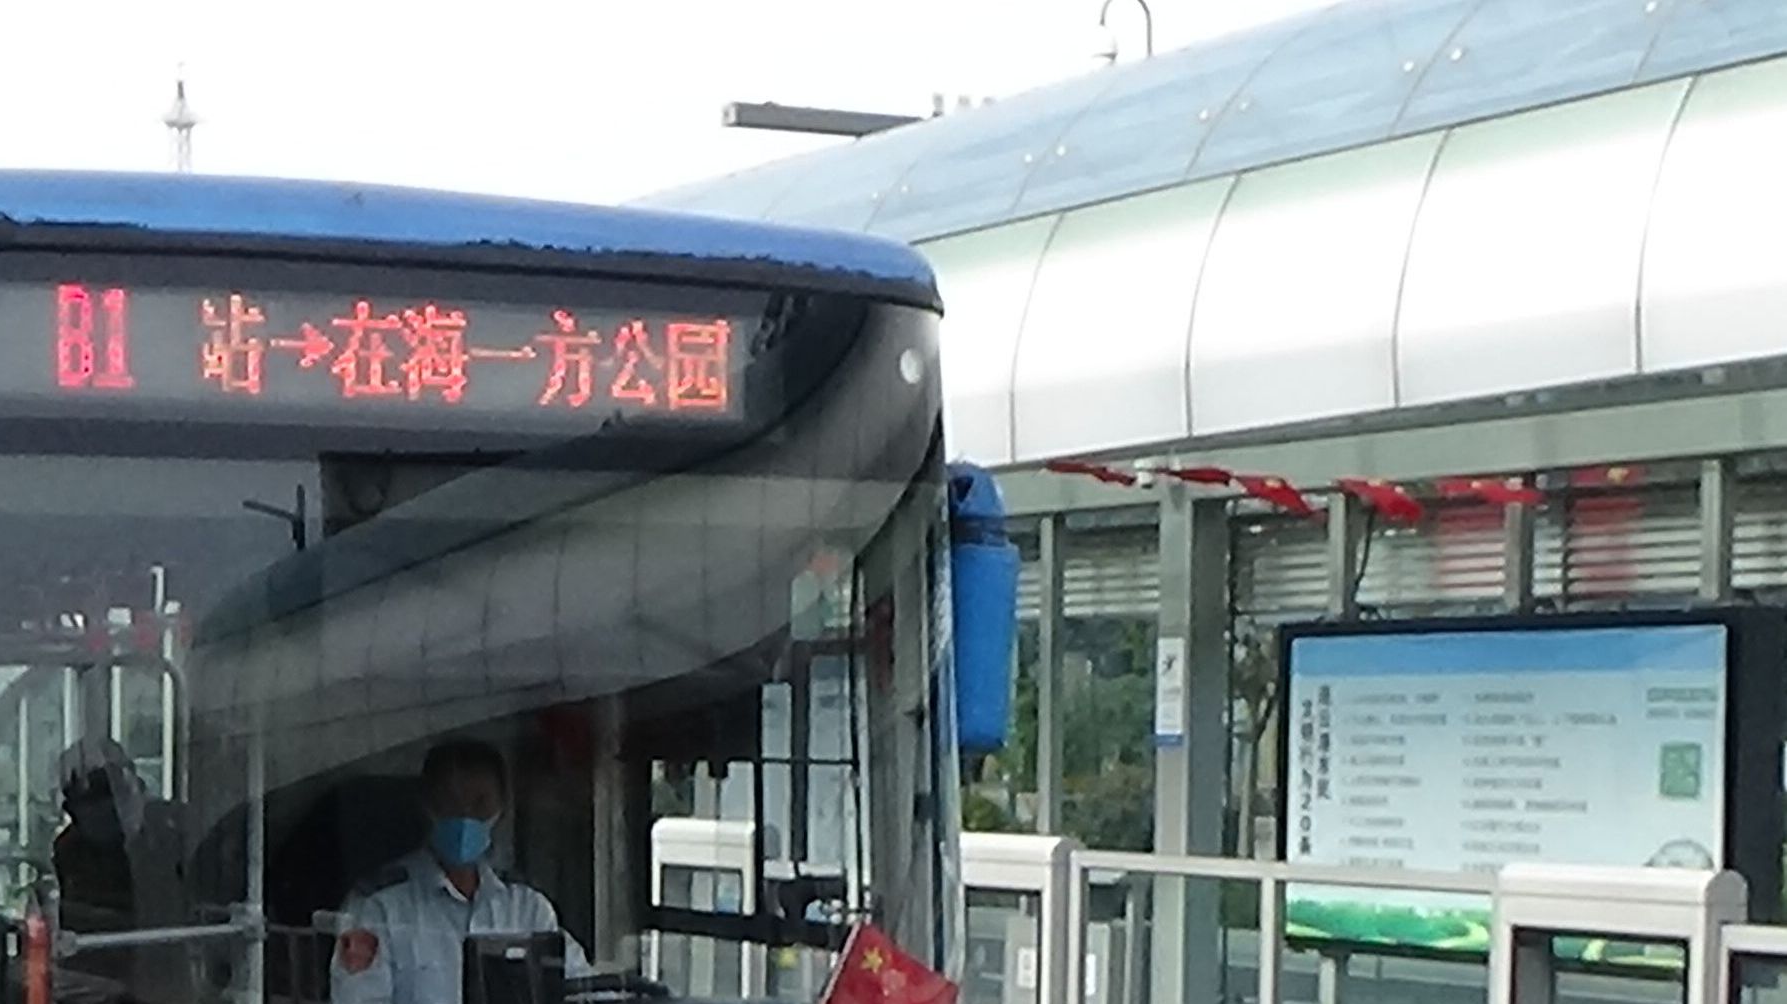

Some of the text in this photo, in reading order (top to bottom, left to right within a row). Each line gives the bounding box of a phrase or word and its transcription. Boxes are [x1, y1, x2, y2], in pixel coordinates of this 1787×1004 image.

[57, 284, 135, 387] B1
[331, 300, 730, 411] 在海一方公园
